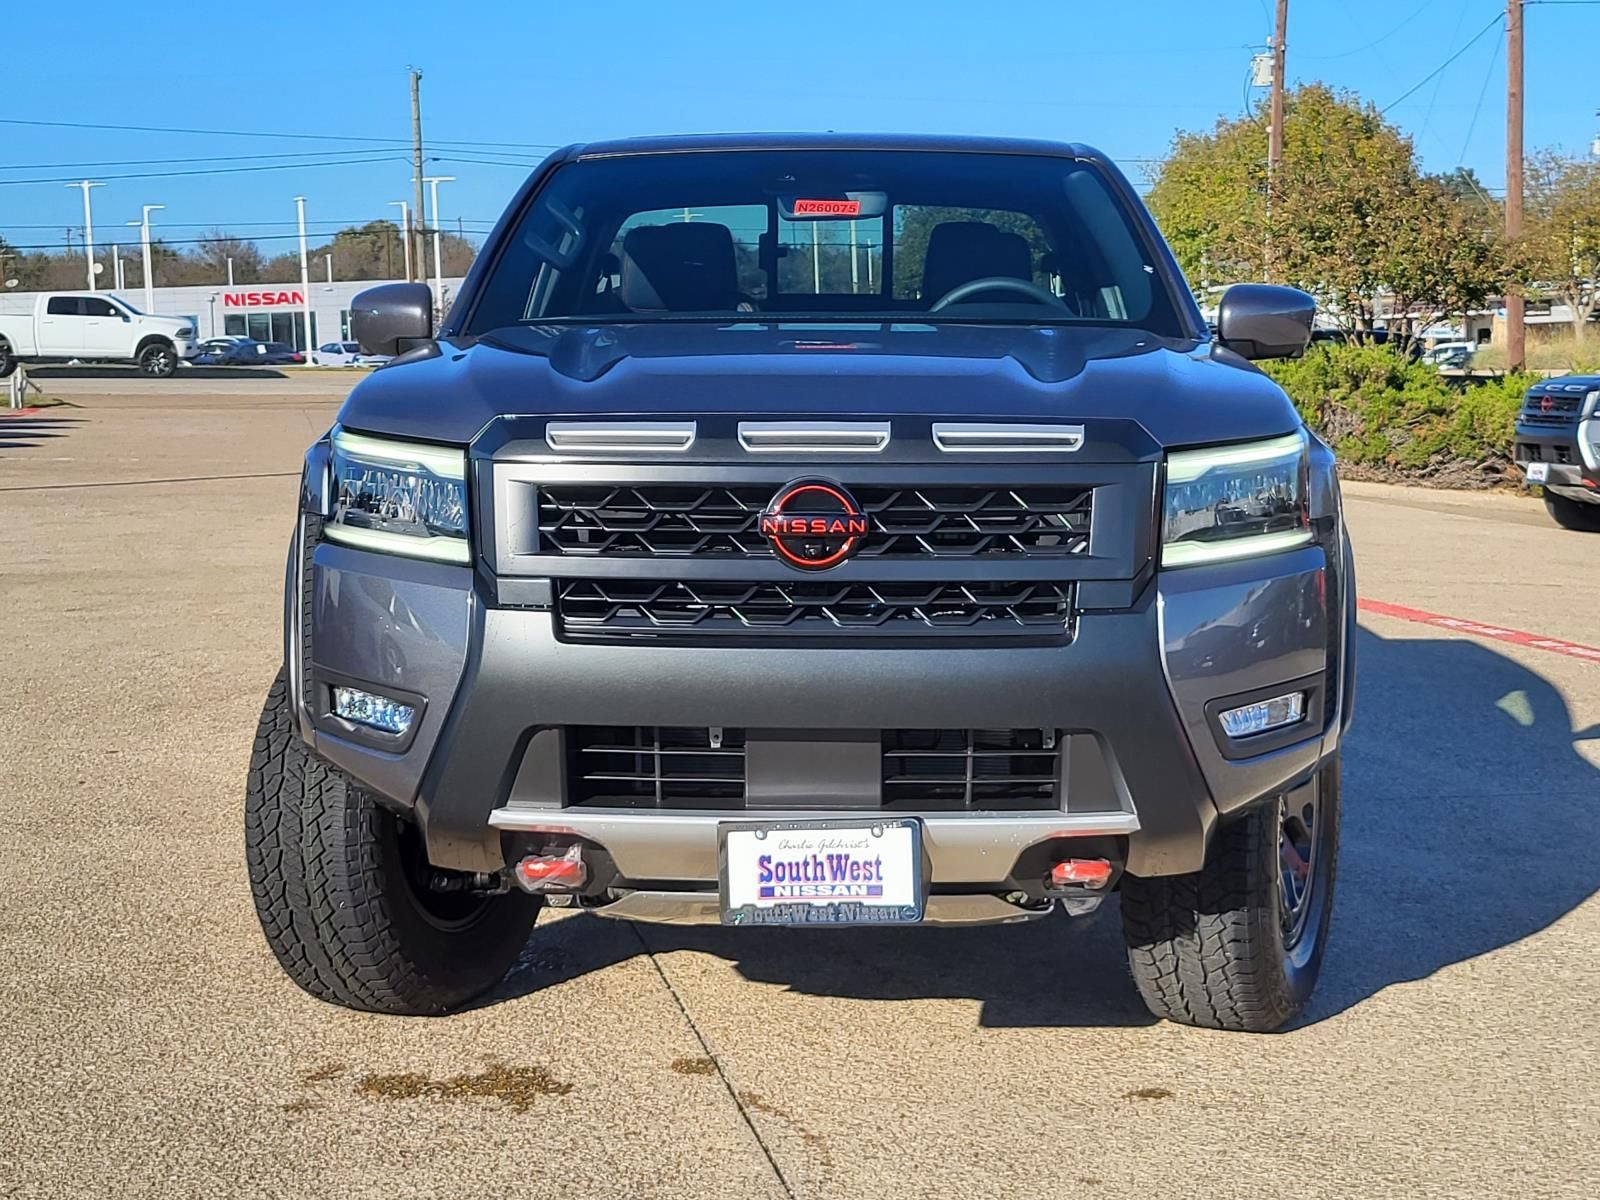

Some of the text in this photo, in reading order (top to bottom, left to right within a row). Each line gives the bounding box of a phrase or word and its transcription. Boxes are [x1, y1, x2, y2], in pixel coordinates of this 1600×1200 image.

[798, 203, 857, 213] N260075
[225, 291, 304, 306] NISSAN
[762, 518, 866, 534] NISSAN
[759, 854, 883, 883] SouthWest
[773, 885, 868, 897] NISSAN
